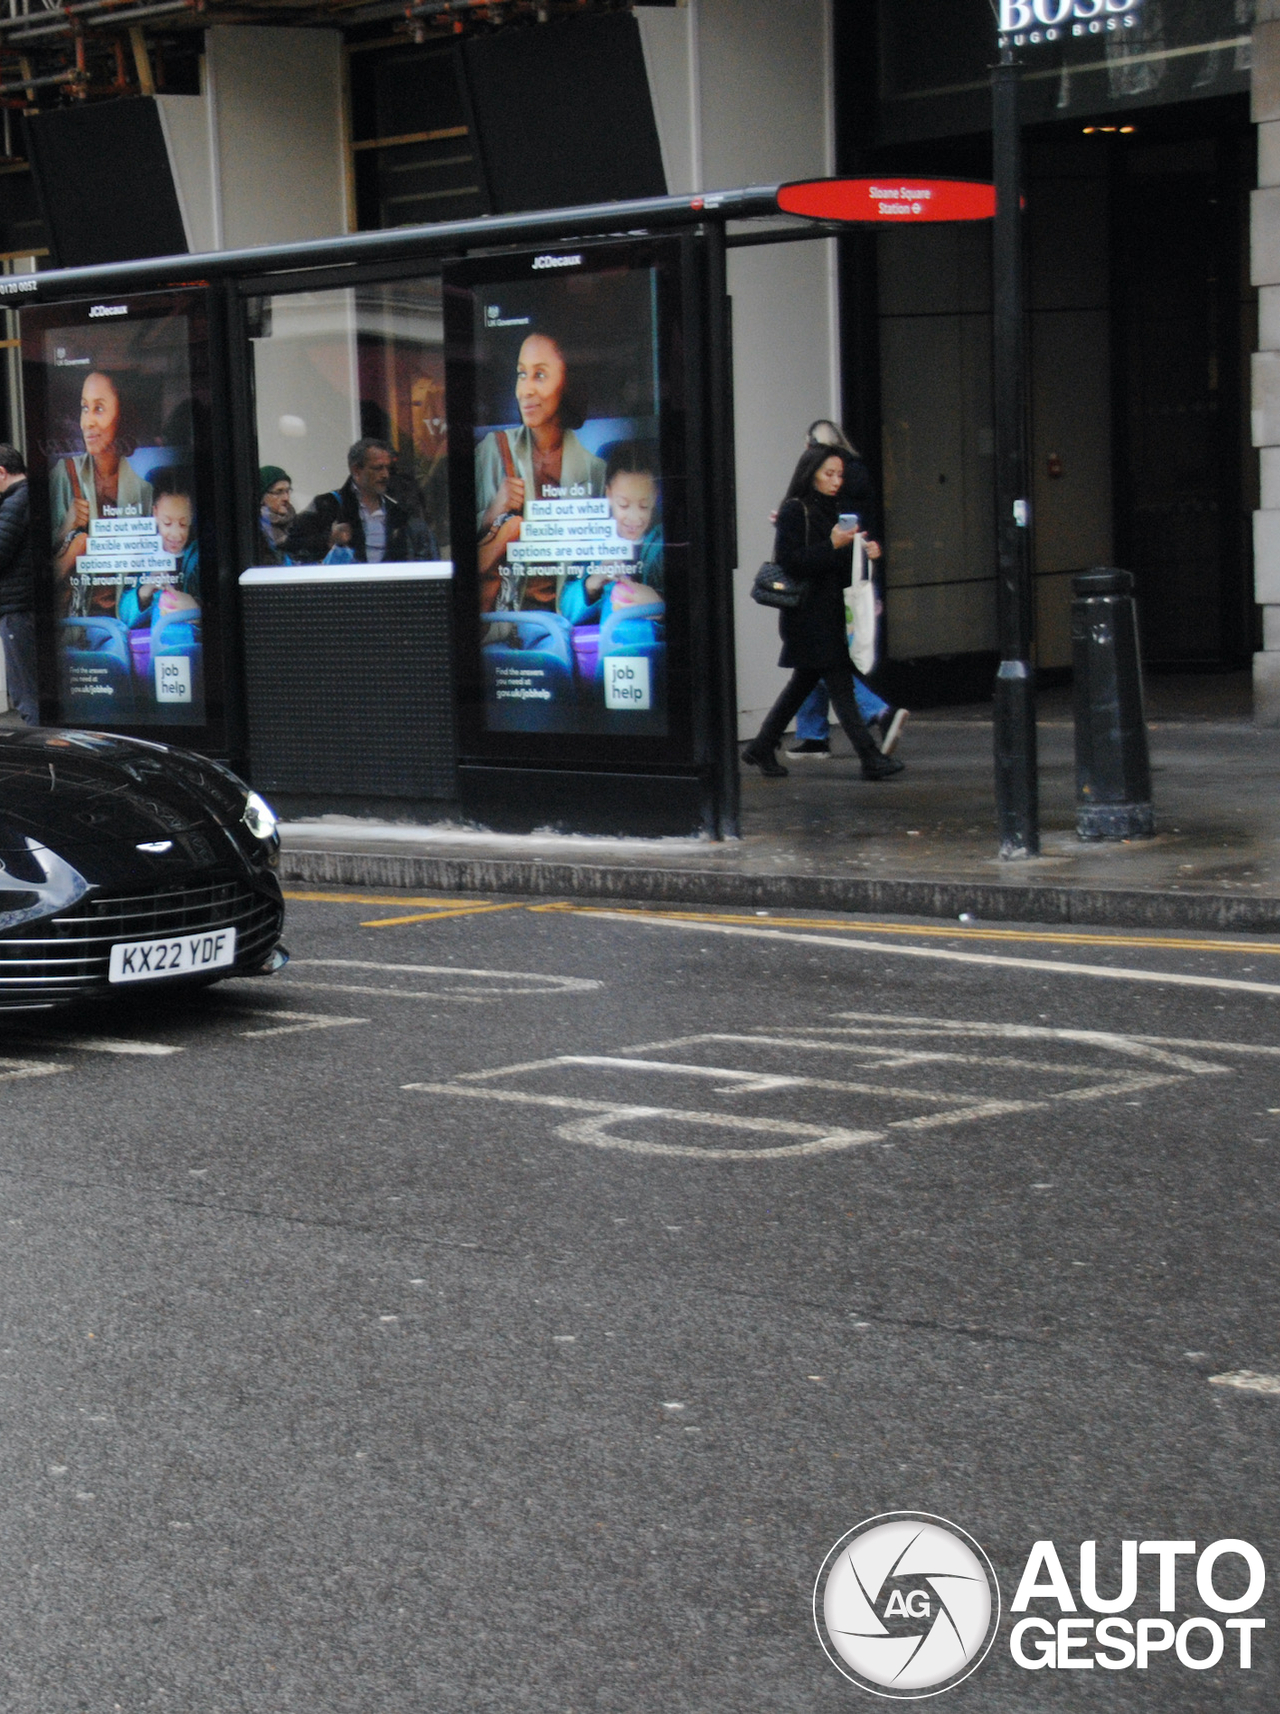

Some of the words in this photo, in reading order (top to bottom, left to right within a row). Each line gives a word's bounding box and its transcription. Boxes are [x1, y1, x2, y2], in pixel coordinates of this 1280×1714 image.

[998, 28, 1057, 48] HUGO
[1072, 15, 1135, 37] BOSS
[869, 187, 898, 199] Sloane
[900, 188, 931, 200] Square
[878, 202, 910, 215] Station
[531, 254, 581, 270] JCDecaux
[0, 282, 18, 295] 0120
[19, 280, 38, 293] 0052
[89, 305, 128, 318] JCDecaux
[542, 484, 567, 497] How
[569, 483, 585, 496] do
[103, 504, 123, 516] How
[125, 503, 137, 515] do
[531, 503, 552, 516] find
[555, 505, 574, 515] out
[577, 502, 605, 514] what
[94, 521, 111, 533] find
[114, 523, 129, 532] out
[131, 520, 153, 531] what
[525, 523, 564, 537] flexible
[567, 522, 612, 538] working
[90, 539, 120, 551] flexible
[124, 539, 159, 552] working
[511, 545, 552, 560] options
[555, 546, 574, 556] are
[576, 546, 595, 556] out
[597, 542, 628, 555] there
[80, 558, 112, 571] options
[114, 560, 128, 568] are
[130, 559, 146, 568] out
[148, 556, 172, 567] there
[498, 565, 510, 576] to
[512, 562, 525, 576] fit
[527, 562, 566, 576] around
[567, 565, 584, 579] my
[586, 560, 644, 578] daughter?
[70, 576, 79, 586] to
[81, 574, 91, 585] fit
[92, 573, 123, 586] around
[124, 576, 137, 588] my
[139, 572, 184, 587] daughter?
[69, 666, 80, 674] Find
[161, 663, 179, 680] job
[495, 667, 508, 676] Find
[508, 667, 519, 676] the
[611, 664, 635, 683] job
[508, 677, 524, 685] need
[161, 681, 186, 697] help
[496, 687, 552, 700] gov.uk/jobhelp
[612, 684, 643, 703] help
[122, 943, 182, 974] KX22
[190, 934, 226, 966] YDF
